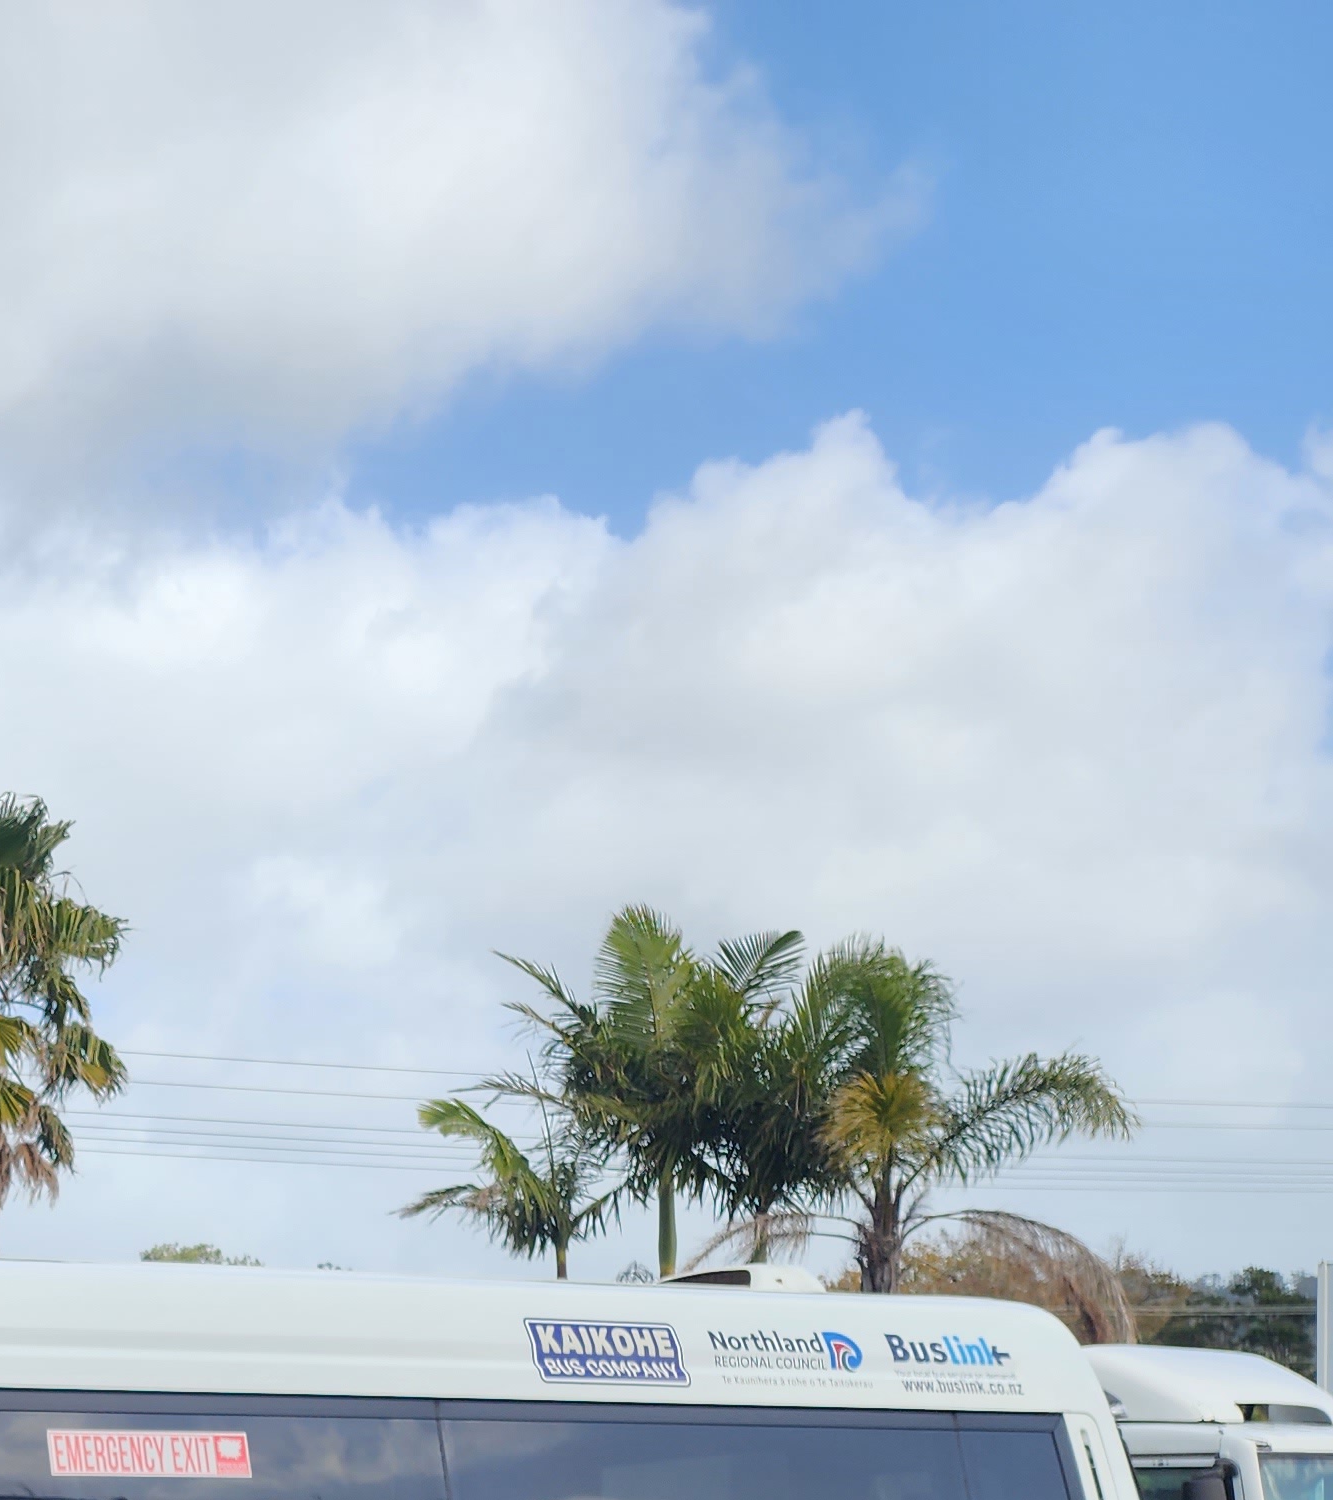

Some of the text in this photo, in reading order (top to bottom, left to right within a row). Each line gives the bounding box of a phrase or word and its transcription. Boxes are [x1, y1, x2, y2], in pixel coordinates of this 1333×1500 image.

[536, 1324, 675, 1358] KAIKOHE
[707, 1330, 825, 1353] Northland
[884, 1333, 1010, 1367] Buslink
[544, 1358, 678, 1379] BUS COMPANY
[714, 1356, 828, 1371] REGIONAL COUNCIL
[902, 1380, 1025, 1396] www.buslink.co.nz
[53, 1435, 212, 1473] EMERGENCY EXIT
